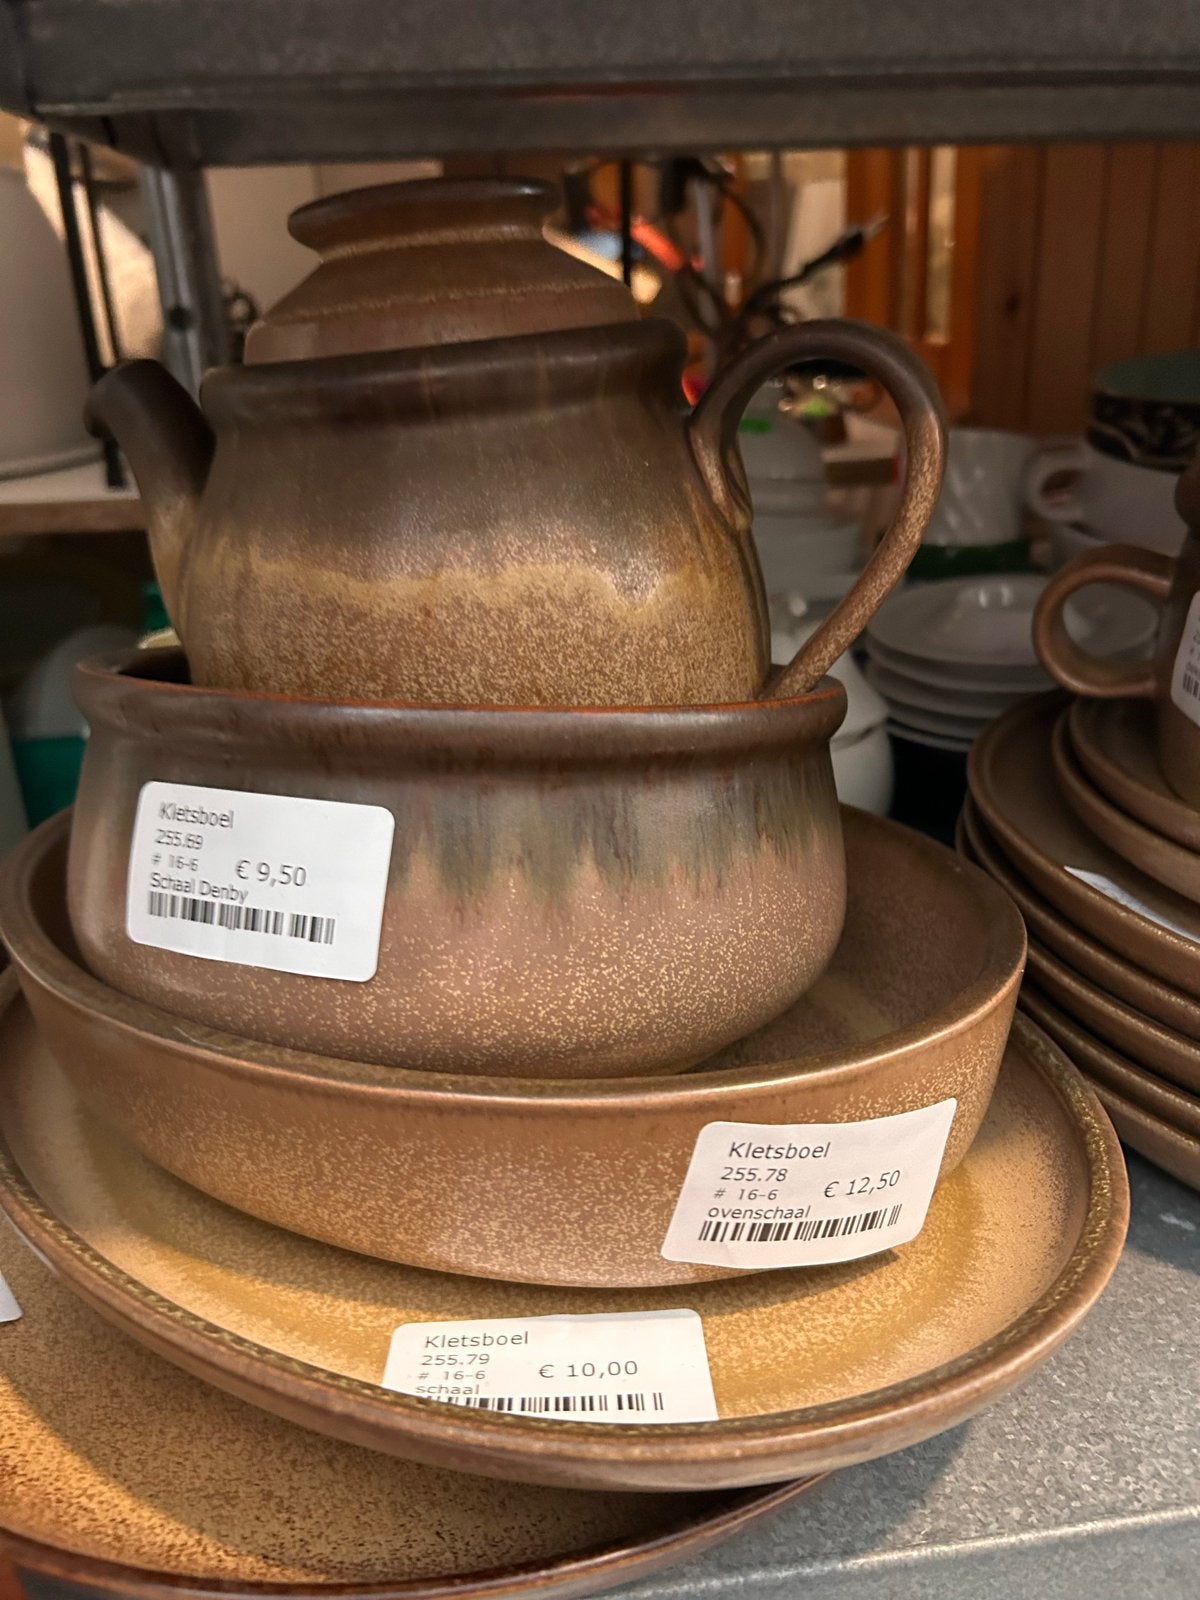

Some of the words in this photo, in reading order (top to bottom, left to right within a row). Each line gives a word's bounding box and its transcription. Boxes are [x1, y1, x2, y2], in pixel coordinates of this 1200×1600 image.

[159, 802, 234, 829] Kletsboel
[152, 854, 162, 865] #
[168, 854, 199, 872] 16-6
[256, 861, 306, 887] 9,50
[150, 873, 195, 894] Schaal
[200, 880, 248, 905] Denby
[728, 1142, 831, 1159] Kletsboel
[720, 1167, 788, 1182] 255.78
[824, 1181, 839, 1198] €
[845, 1170, 900, 1196] 12,50
[714, 1189, 726, 1198] #
[738, 1188, 779, 1200] 16-6
[708, 1206, 811, 1220] ovenschaal
[424, 1331, 529, 1348] Kletsboel
[421, 1354, 490, 1366] 255.79
[418, 1372, 430, 1380] #
[443, 1370, 486, 1381] 16-6
[539, 1364, 554, 1378] €
[567, 1360, 638, 1380] 10,00
[415, 1384, 480, 1395] schaal
